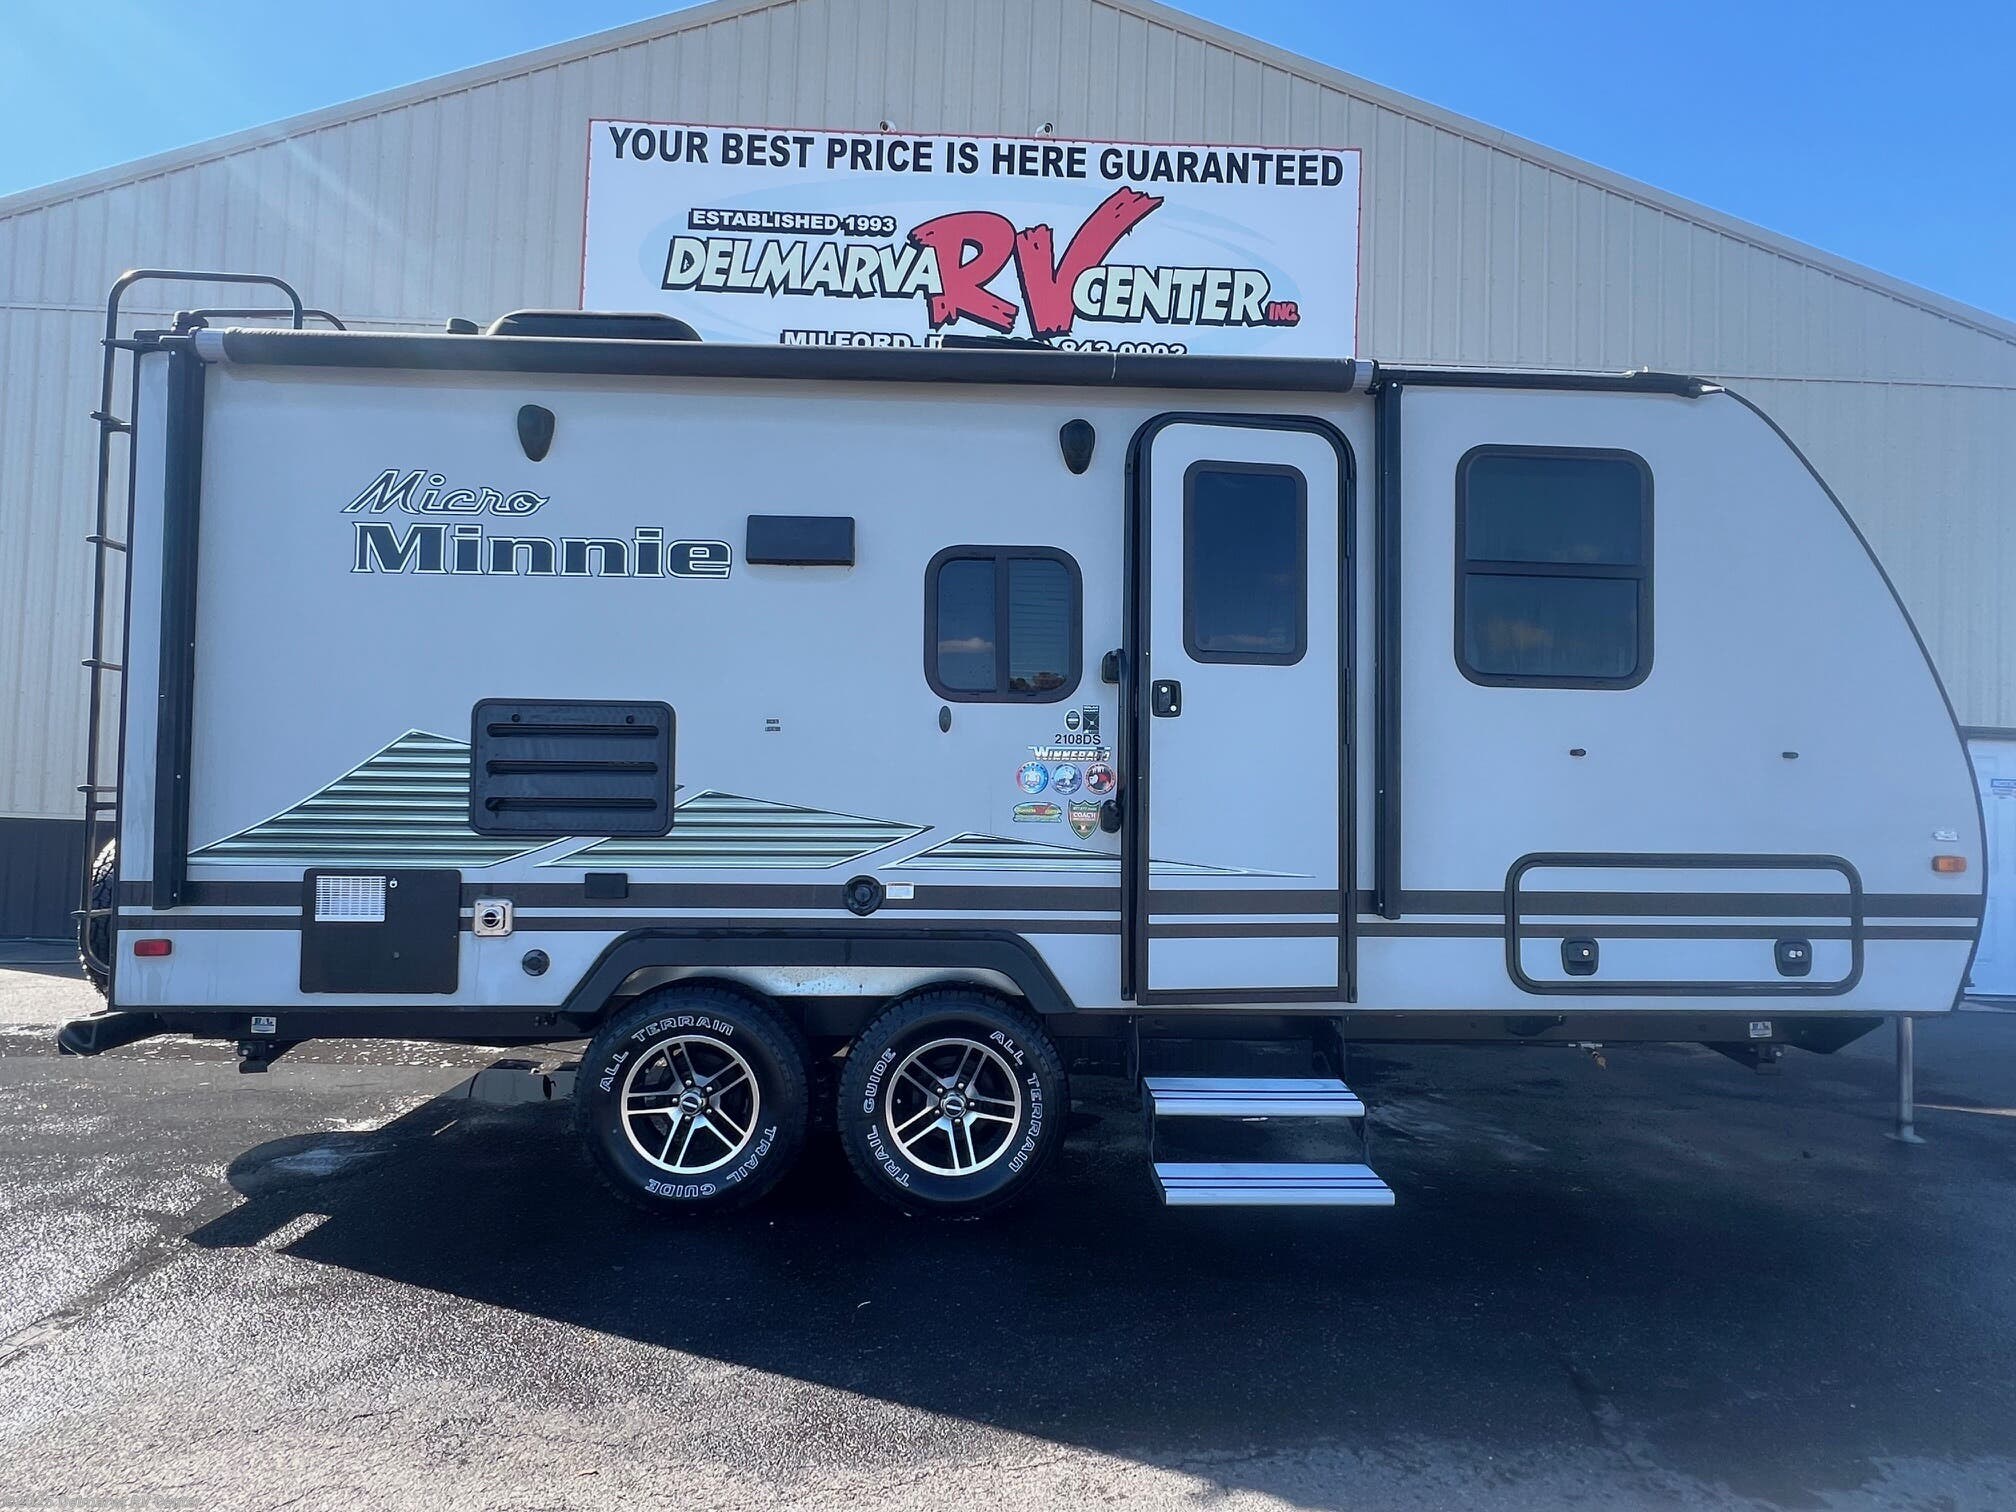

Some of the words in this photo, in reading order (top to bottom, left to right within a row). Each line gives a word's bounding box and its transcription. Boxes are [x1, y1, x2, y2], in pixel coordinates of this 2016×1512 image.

[609, 126, 709, 164] YOUR
[722, 133, 815, 168] BEST
[826, 138, 933, 173] PRICE
[946, 141, 979, 174] IS
[992, 143, 1087, 178] HERE
[1100, 148, 1344, 187] GUARANTEED
[688, 208, 840, 234] ESTABLISHED
[843, 214, 897, 237] 1993
[661, 236, 944, 300] DELMARVA
[907, 186, 1164, 340] RV
[1072, 264, 1271, 327] CENTER
[1266, 301, 1301, 326] INC.
[780, 330, 922, 348] MILFORD
[340, 468, 551, 517] Micro
[350, 520, 733, 580] Minnie
[1054, 733, 1102, 746] 2108DS
[599, 1050, 630, 1093] ALL
[631, 1015, 735, 1043] TERRAIN
[989, 1030, 1029, 1066] ALL
[863, 1047, 897, 1114] GUIDE
[1008, 1072, 1043, 1173] TERRAIN
[726, 1125, 778, 1183] TRAIL
[866, 1124, 910, 1188] TRAIL
[644, 1178, 717, 1198] GUIDE
